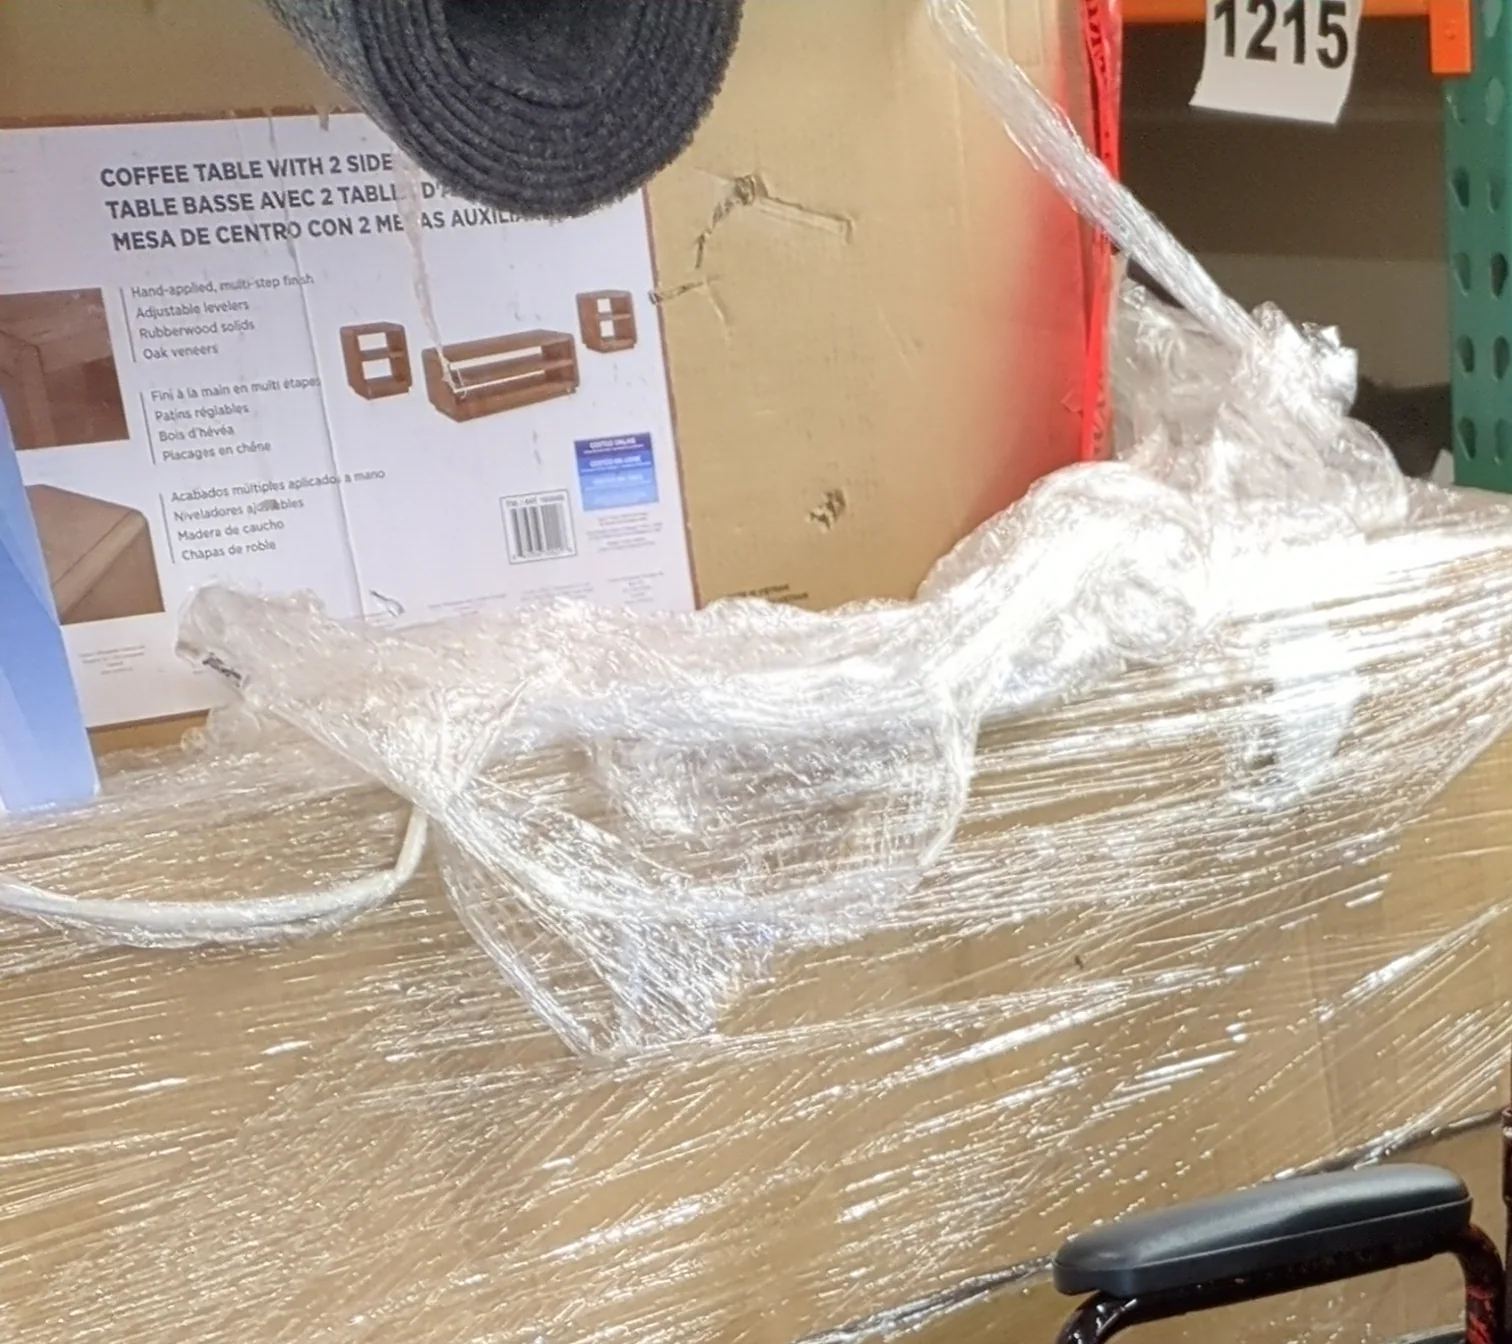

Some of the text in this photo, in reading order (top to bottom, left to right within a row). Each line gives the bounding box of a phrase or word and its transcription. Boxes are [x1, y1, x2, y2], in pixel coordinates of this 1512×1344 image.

[1213, 0, 1349, 69] 1215
[99, 152, 393, 188] COFFEE TABLE WITH 2 SIDE
[104, 197, 179, 219] TABLE
[182, 192, 255, 215] BASSE
[259, 188, 316, 210] AVEC
[320, 187, 333, 206] 2
[337, 183, 397, 204] TABL
[111, 229, 176, 251] MESA
[179, 227, 211, 247] DE
[215, 221, 301, 244] CENTRO
[307, 216, 353, 238] CON
[358, 215, 372, 234] 2
[375, 210, 445, 233] MEAS
[131, 281, 218, 298] Hand-applied,
[219, 276, 280, 291] multi-step
[136, 300, 250, 319] Adjustable levelers
[139, 319, 255, 339] Rubberwood solids
[143, 343, 219, 360] Oak veneers
[151, 389, 174, 402] Fini
[187, 386, 199, 399] la
[201, 384, 231, 398] main
[233, 383, 249, 394] en
[155, 403, 250, 422] Patins réglables
[158, 429, 185, 442] Bois
[162, 447, 216, 462] Placages
[218, 445, 234, 456] en
[170, 487, 230, 503] Acabados
[232, 479, 285, 496] múltiples
[354, 469, 386, 481] mano
[173, 504, 243, 522] Niveladores
[178, 519, 285, 542] Madera de caucho
[181, 538, 276, 561] Chapas de roble
